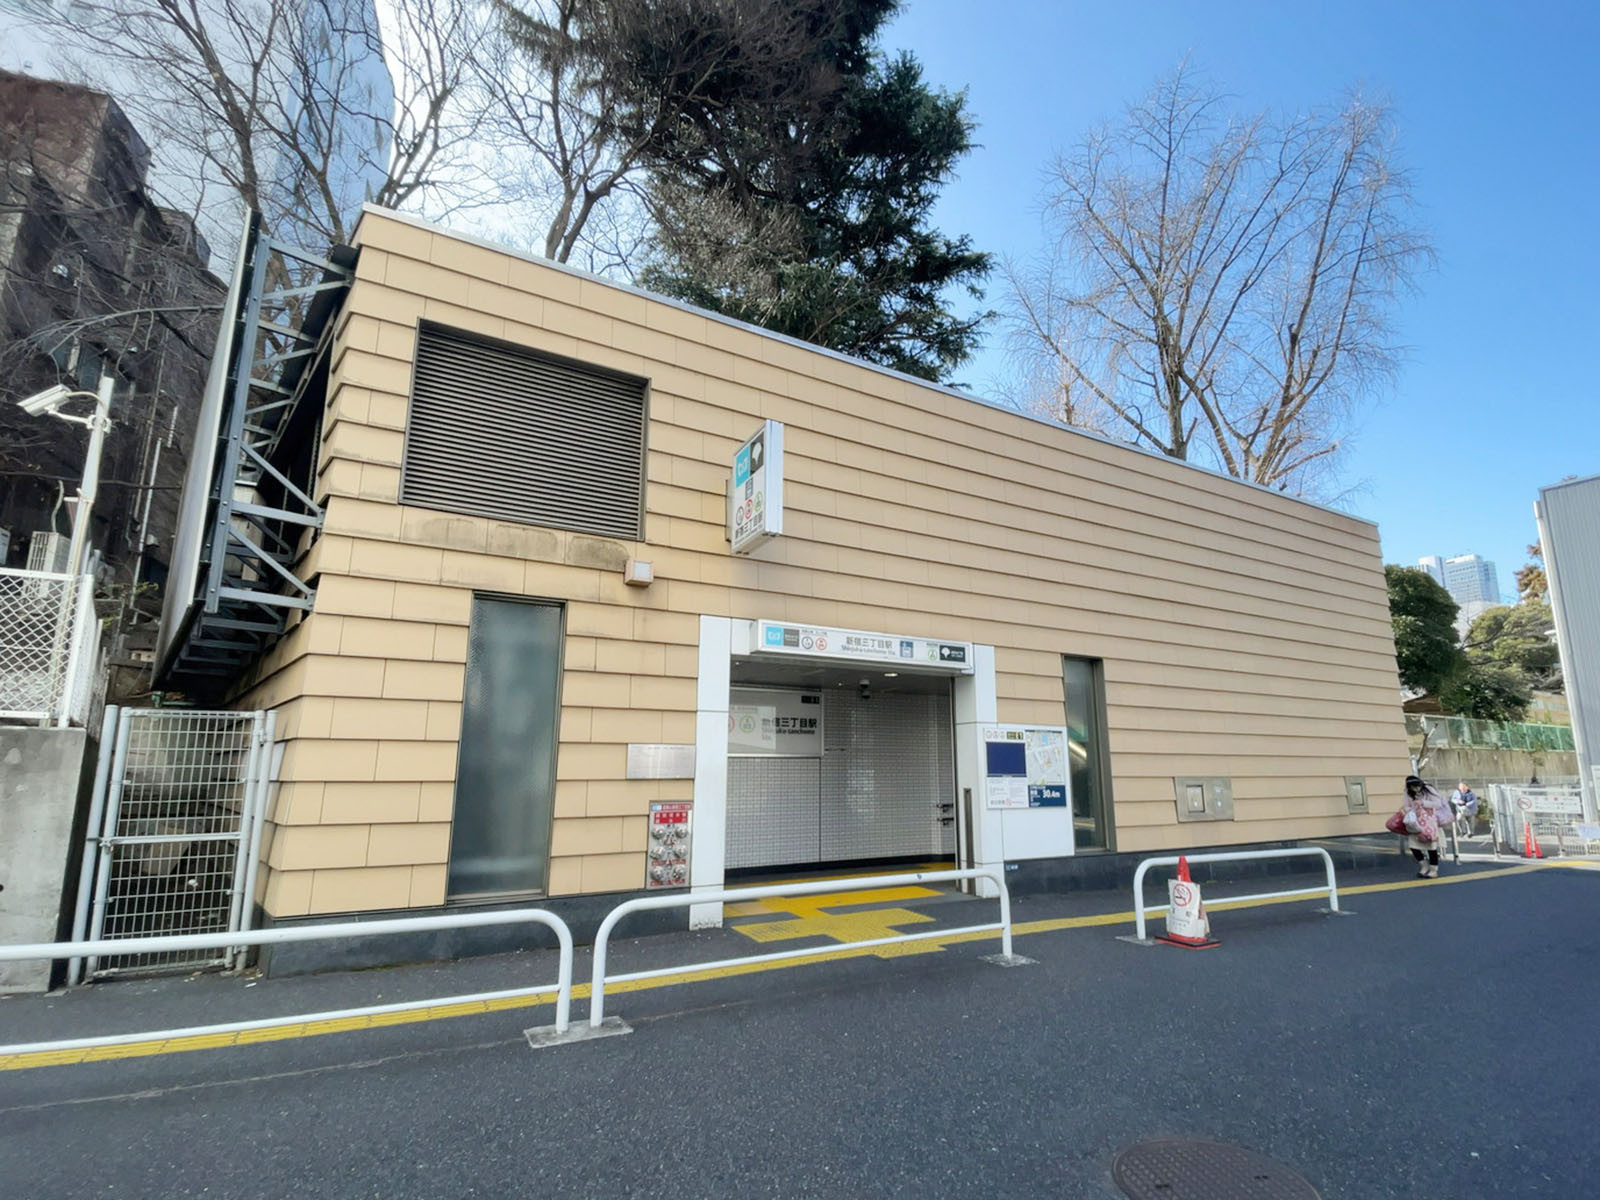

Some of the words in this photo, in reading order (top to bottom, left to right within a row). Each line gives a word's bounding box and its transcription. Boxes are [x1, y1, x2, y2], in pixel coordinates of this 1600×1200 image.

[846, 635, 893, 648] 新宿三丁目駅
[1042, 789, 1061, 799] 30.4m
